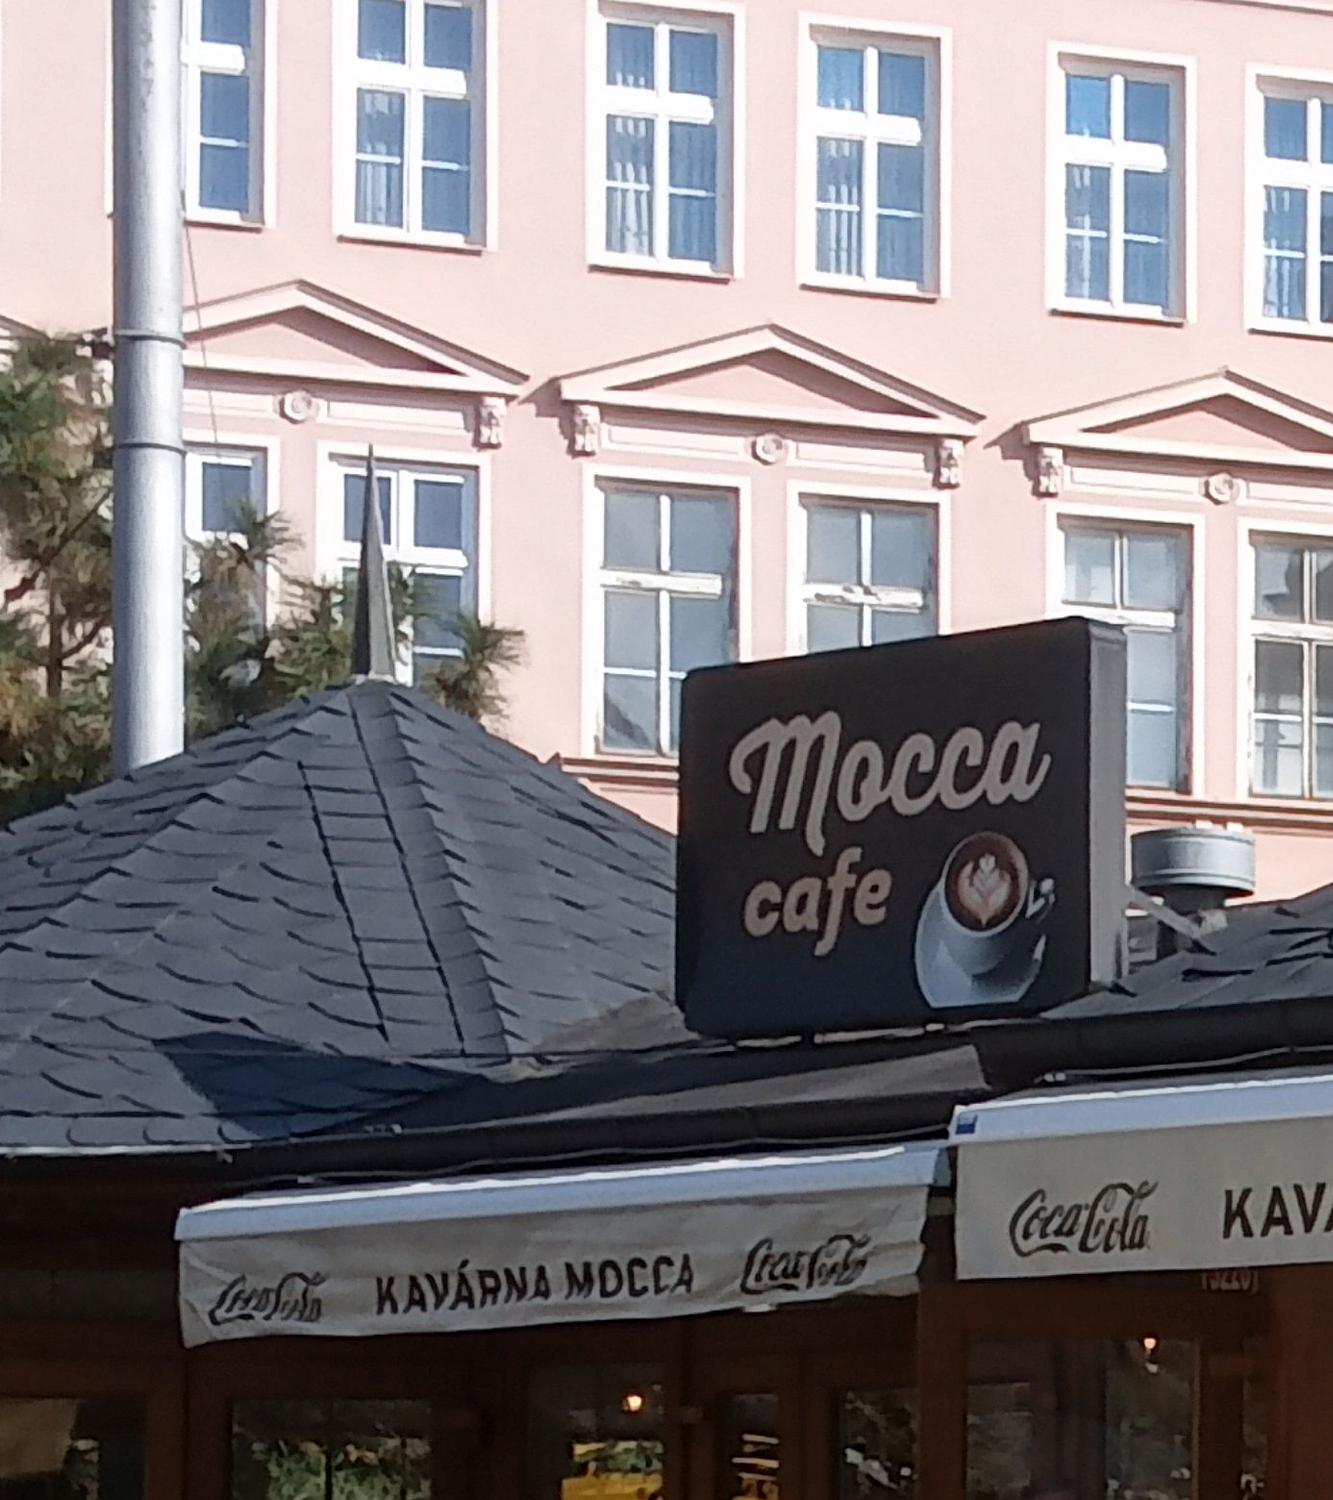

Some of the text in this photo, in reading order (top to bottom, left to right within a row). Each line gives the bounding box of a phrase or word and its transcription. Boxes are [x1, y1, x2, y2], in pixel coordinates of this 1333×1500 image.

[728, 709, 1052, 857] Mocca
[742, 846, 893, 958] cafe
[1009, 1179, 1159, 1258] Coca-Cola
[375, 1253, 694, 1316] KAVÁRNA MOCCA
